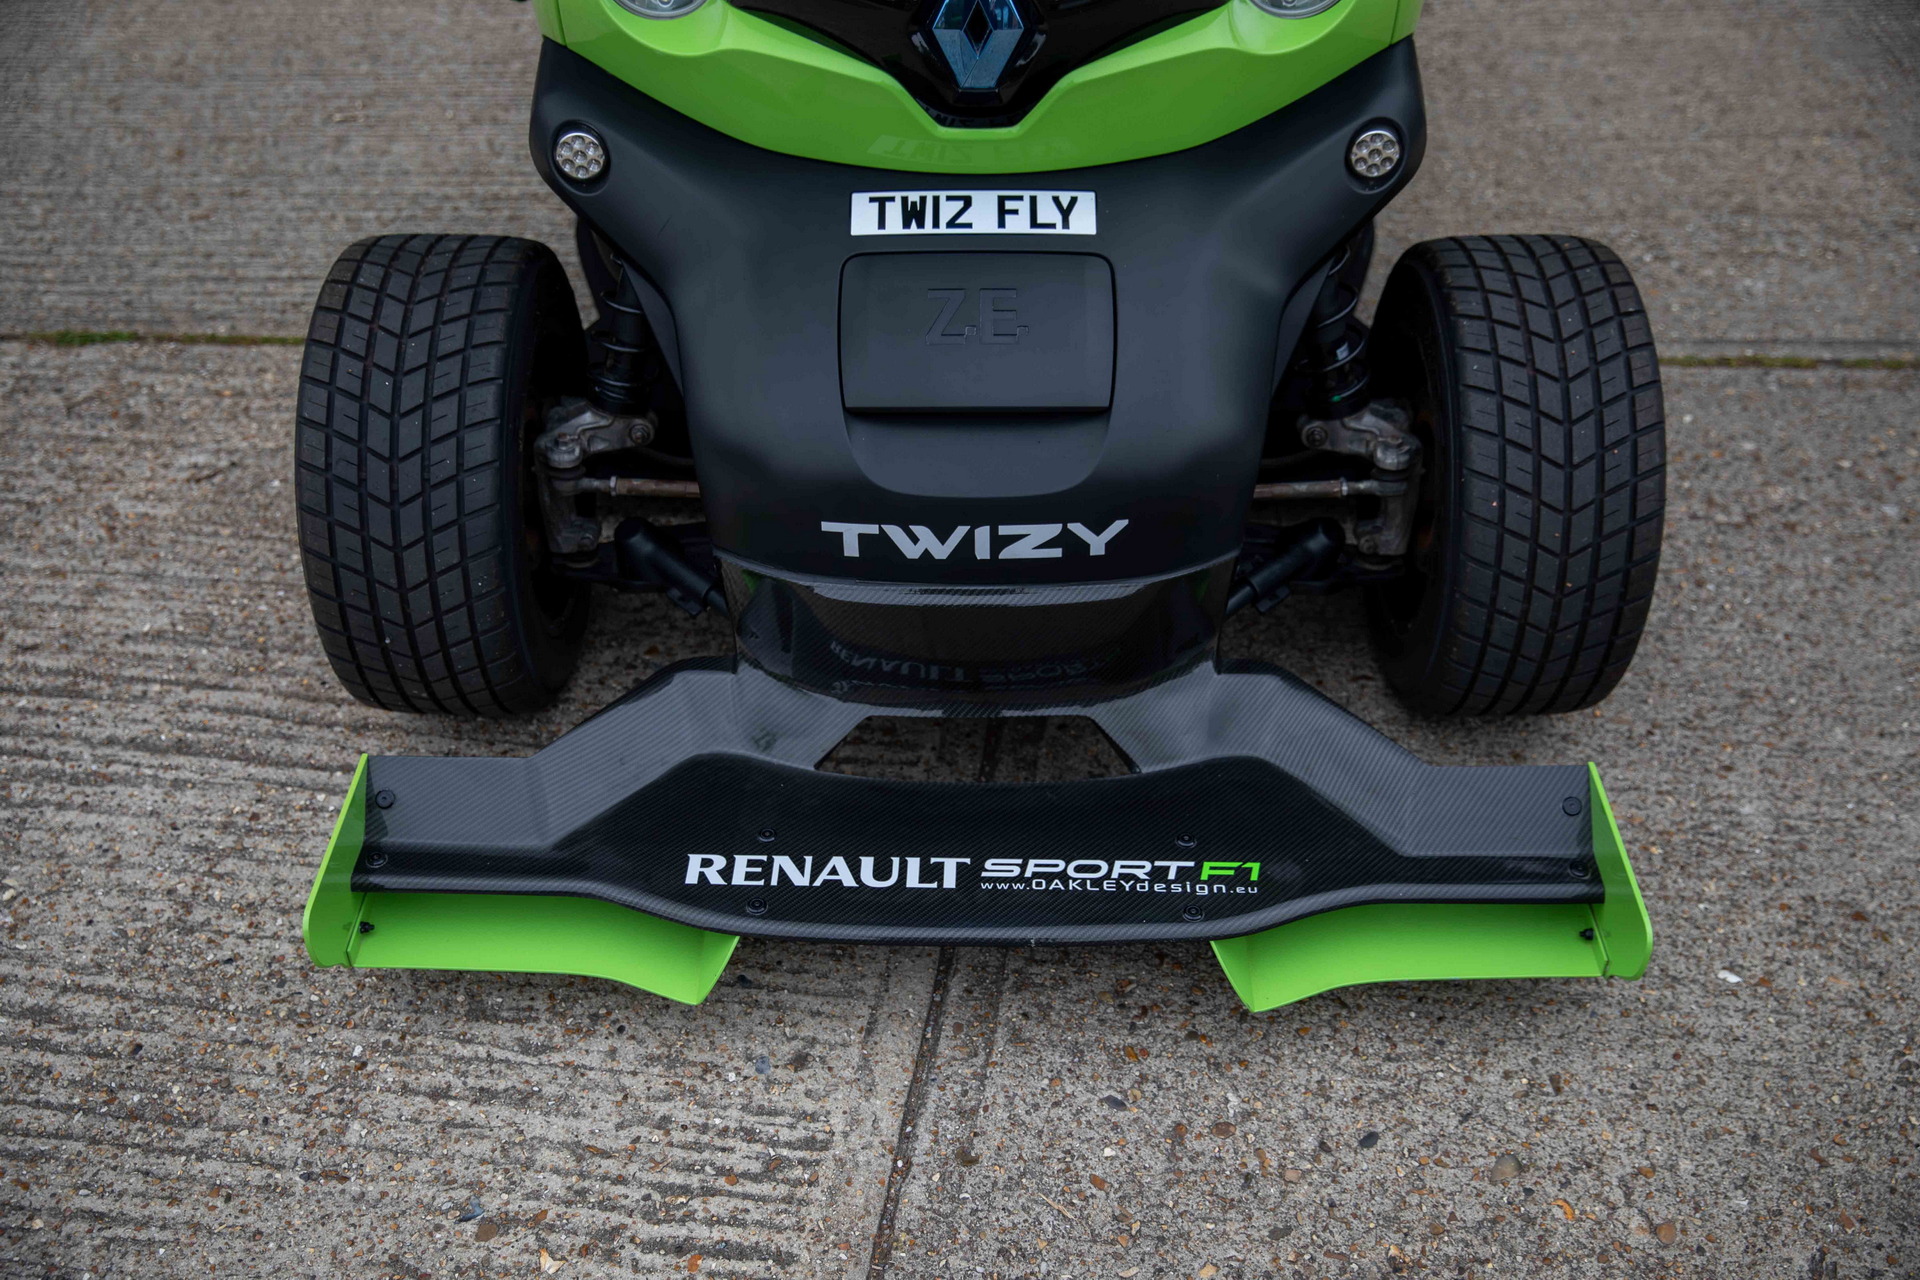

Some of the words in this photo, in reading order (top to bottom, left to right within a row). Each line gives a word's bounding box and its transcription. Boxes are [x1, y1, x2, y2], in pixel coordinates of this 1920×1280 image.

[869, 195, 973, 230] TWIZ
[997, 195, 1078, 230] FLY
[821, 519, 1129, 560] TWIZY
[684, 853, 971, 889] RENAULT
[981, 858, 1195, 880] SPORT
[1200, 861, 1261, 881] F1
[980, 878, 1258, 895] www.OAKLEYdesign.eu
